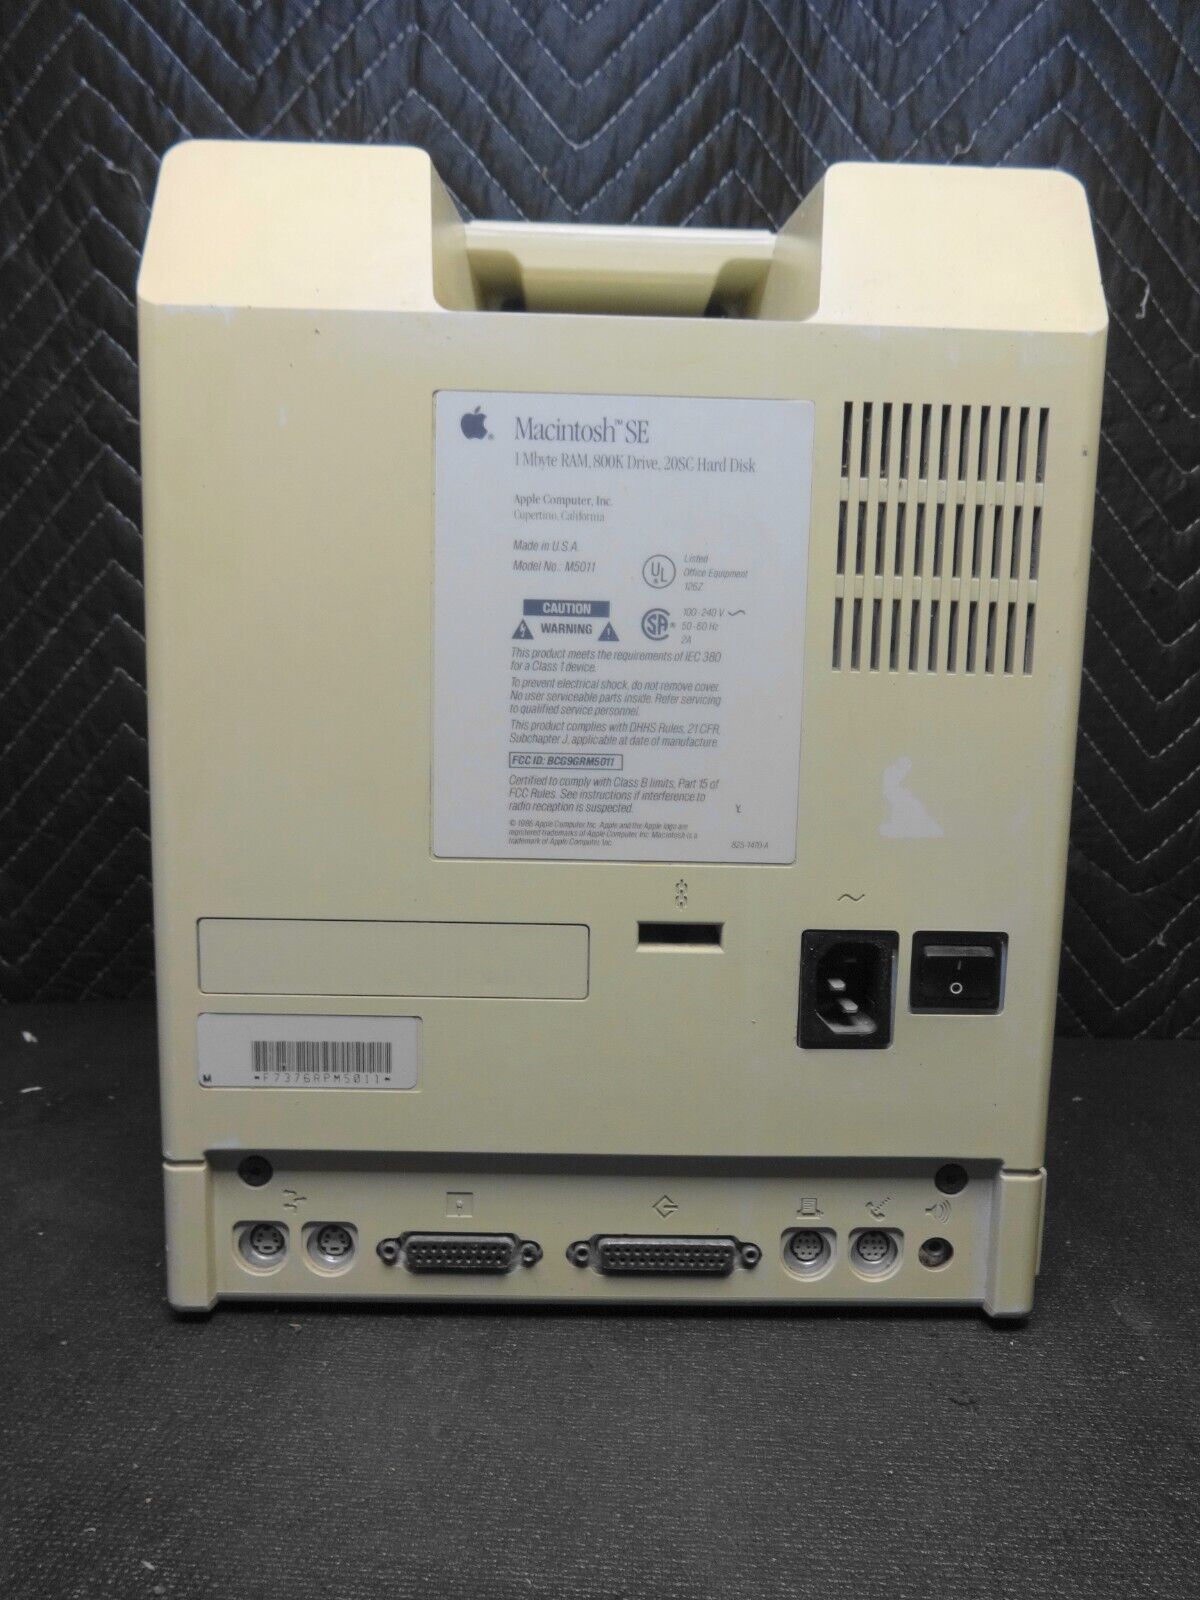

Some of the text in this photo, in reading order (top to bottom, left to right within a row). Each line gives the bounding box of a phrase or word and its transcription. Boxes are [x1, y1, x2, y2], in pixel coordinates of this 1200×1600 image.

[625, 419, 649, 444] SE
[523, 451, 557, 471] Mbyte
[593, 454, 623, 469] 800K
[663, 456, 694, 471] 20SC
[697, 457, 727, 472] Hard
[730, 457, 756, 473] Disk
[514, 493, 541, 507] Apple
[560, 511, 605, 522] California
[513, 539, 539, 551] Made
[541, 541, 550, 551] in
[684, 554, 709, 563] Listed
[512, 559, 541, 572] Model
[564, 561, 596, 573] M5011
[683, 567, 748, 580] Office Equipment
[542, 602, 592, 615] CAUTION
[541, 623, 593, 635] WARNING
[511, 647, 722, 664] This product meets the requirements of IEC 380
[510, 660, 521, 672] for
[532, 660, 558, 673] Class
[512, 677, 520, 688] To
[521, 679, 556, 691] prevent
[557, 679, 600, 690] electrical
[631, 681, 643, 691] do
[644, 681, 659, 692] not
[660, 682, 693, 692] remove
[510, 691, 523, 701] No
[524, 692, 545, 702] user
[546, 692, 598, 703] serviceable
[598, 693, 622, 705] parts
[655, 694, 679, 705] Refer
[680, 696, 721, 708] servicing
[510, 704, 519, 714] to
[520, 704, 559, 716] qualified
[560, 706, 594, 717] service
[512, 719, 530, 731] This
[530, 721, 566, 734] product
[566, 721, 608, 734] complies
[609, 723, 629, 733] with
[630, 722, 657, 734] DHHS
[687, 723, 699, 734] 21
[510, 732, 561, 745] Subchapter
[571, 734, 618, 747] applicable
[618, 736, 629, 746] at
[630, 736, 650, 746] date
[651, 736, 661, 746] of
[511, 755, 531, 766] FCC
[532, 755, 546, 766] ID:
[510, 774, 548, 786] Certified
[549, 776, 558, 787] to
[559, 776, 592, 790] comply
[593, 776, 612, 787] with
[613, 776, 639, 789] Class
[640, 778, 649, 788] B
[678, 778, 698, 789] Part
[699, 778, 708, 789] 15
[710, 778, 720, 790] of
[509, 787, 529, 799] FCC
[560, 788, 579, 800] See
[580, 790, 632, 801] instructions
[641, 791, 695, 802] interference
[696, 792, 706, 802] to
[509, 800, 531, 812] radio
[532, 802, 575, 814] reception
[575, 803, 584, 813] is
[535, 820, 553, 829] Apple
[599, 821, 618, 830] Apple
[620, 822, 631, 830] and
[632, 822, 643, 830] the
[644, 822, 661, 831] Apple
[508, 829, 541, 837] registered
[542, 829, 578, 837] trademarks
[587, 830, 606, 839] Apple
[651, 831, 686, 841] Macintosh
[550, 838, 567, 846] Apple
